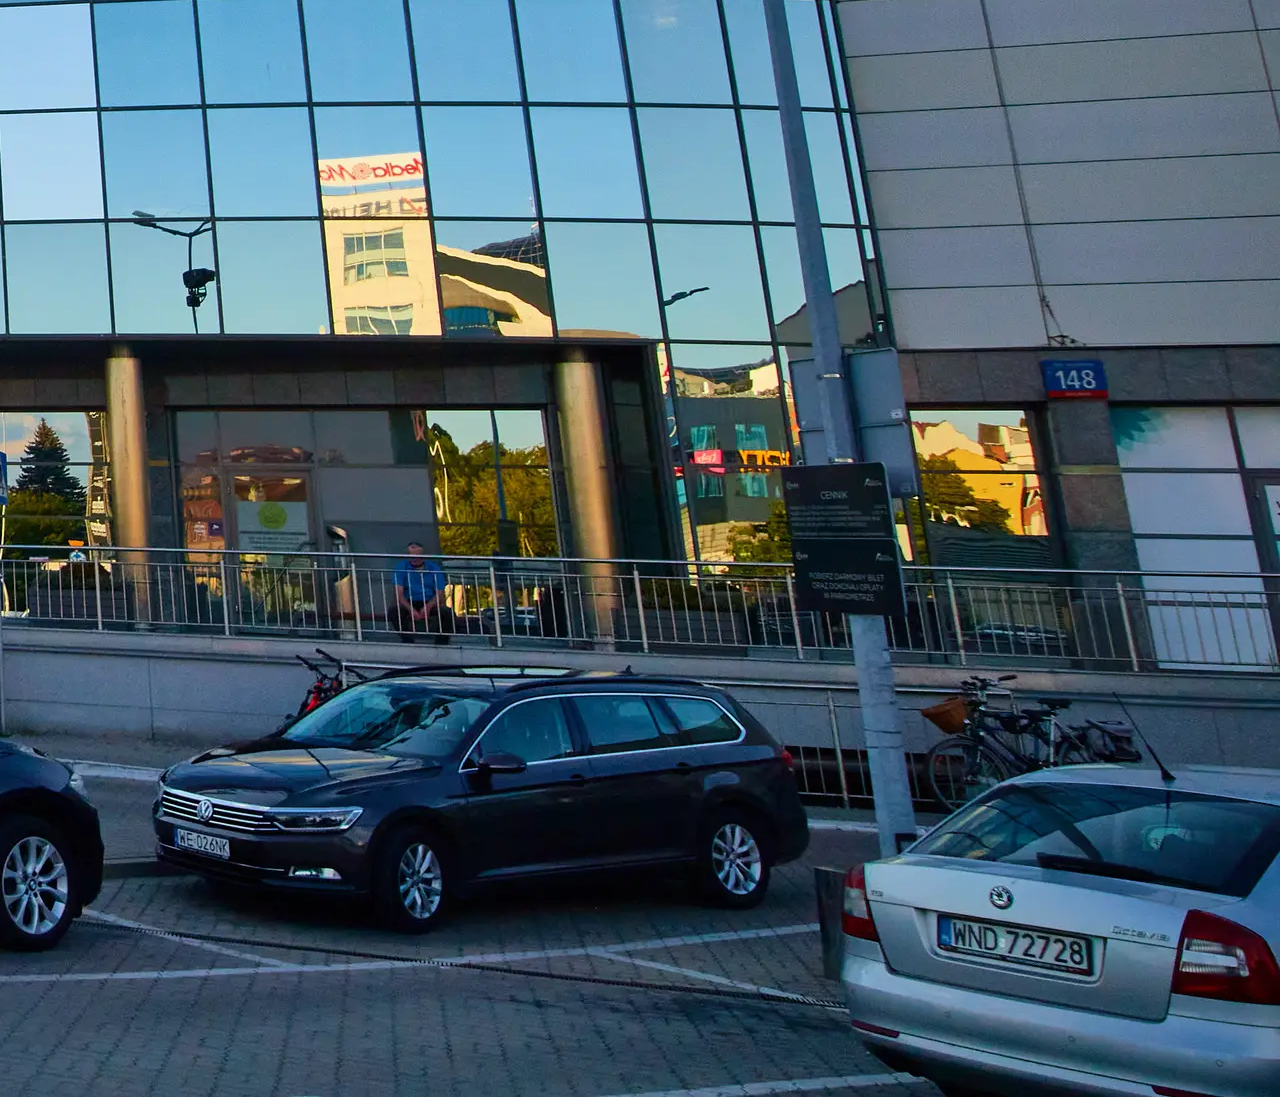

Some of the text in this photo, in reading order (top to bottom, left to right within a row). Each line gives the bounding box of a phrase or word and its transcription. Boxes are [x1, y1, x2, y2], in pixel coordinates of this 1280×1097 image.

[1055, 369, 1097, 389] 148
[820, 490, 848, 500] CENNIK
[179, 830, 229, 856] WE 026NK
[953, 921, 1084, 965] WND 72728
